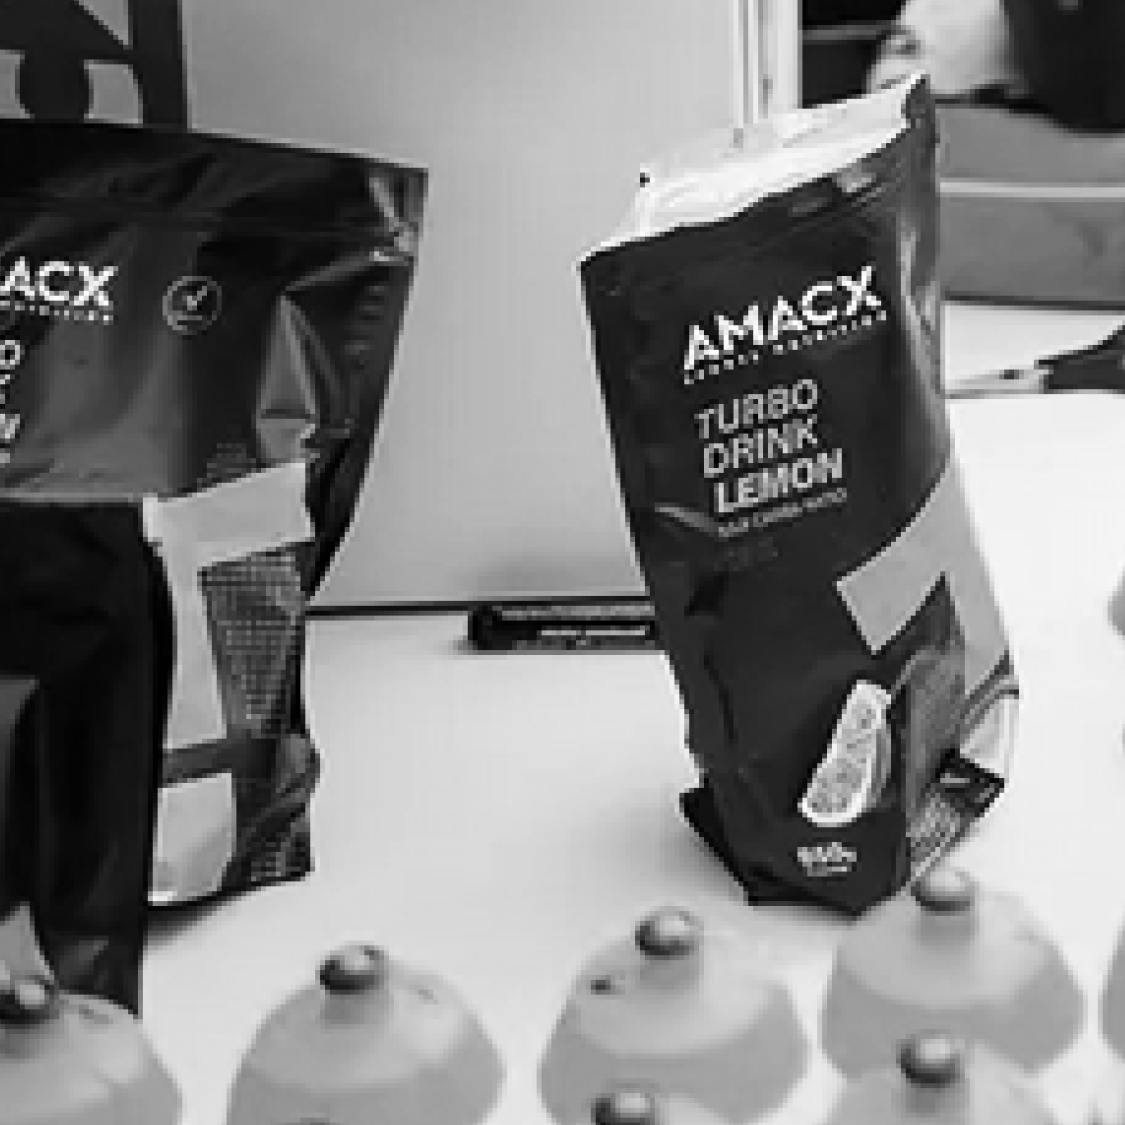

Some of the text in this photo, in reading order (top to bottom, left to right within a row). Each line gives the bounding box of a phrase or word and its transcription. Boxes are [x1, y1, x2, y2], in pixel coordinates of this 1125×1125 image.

[683, 265, 882, 370] AMACX
[695, 379, 817, 438] TURBO
[703, 414, 817, 477] DRINK
[714, 448, 843, 512] LEMON
